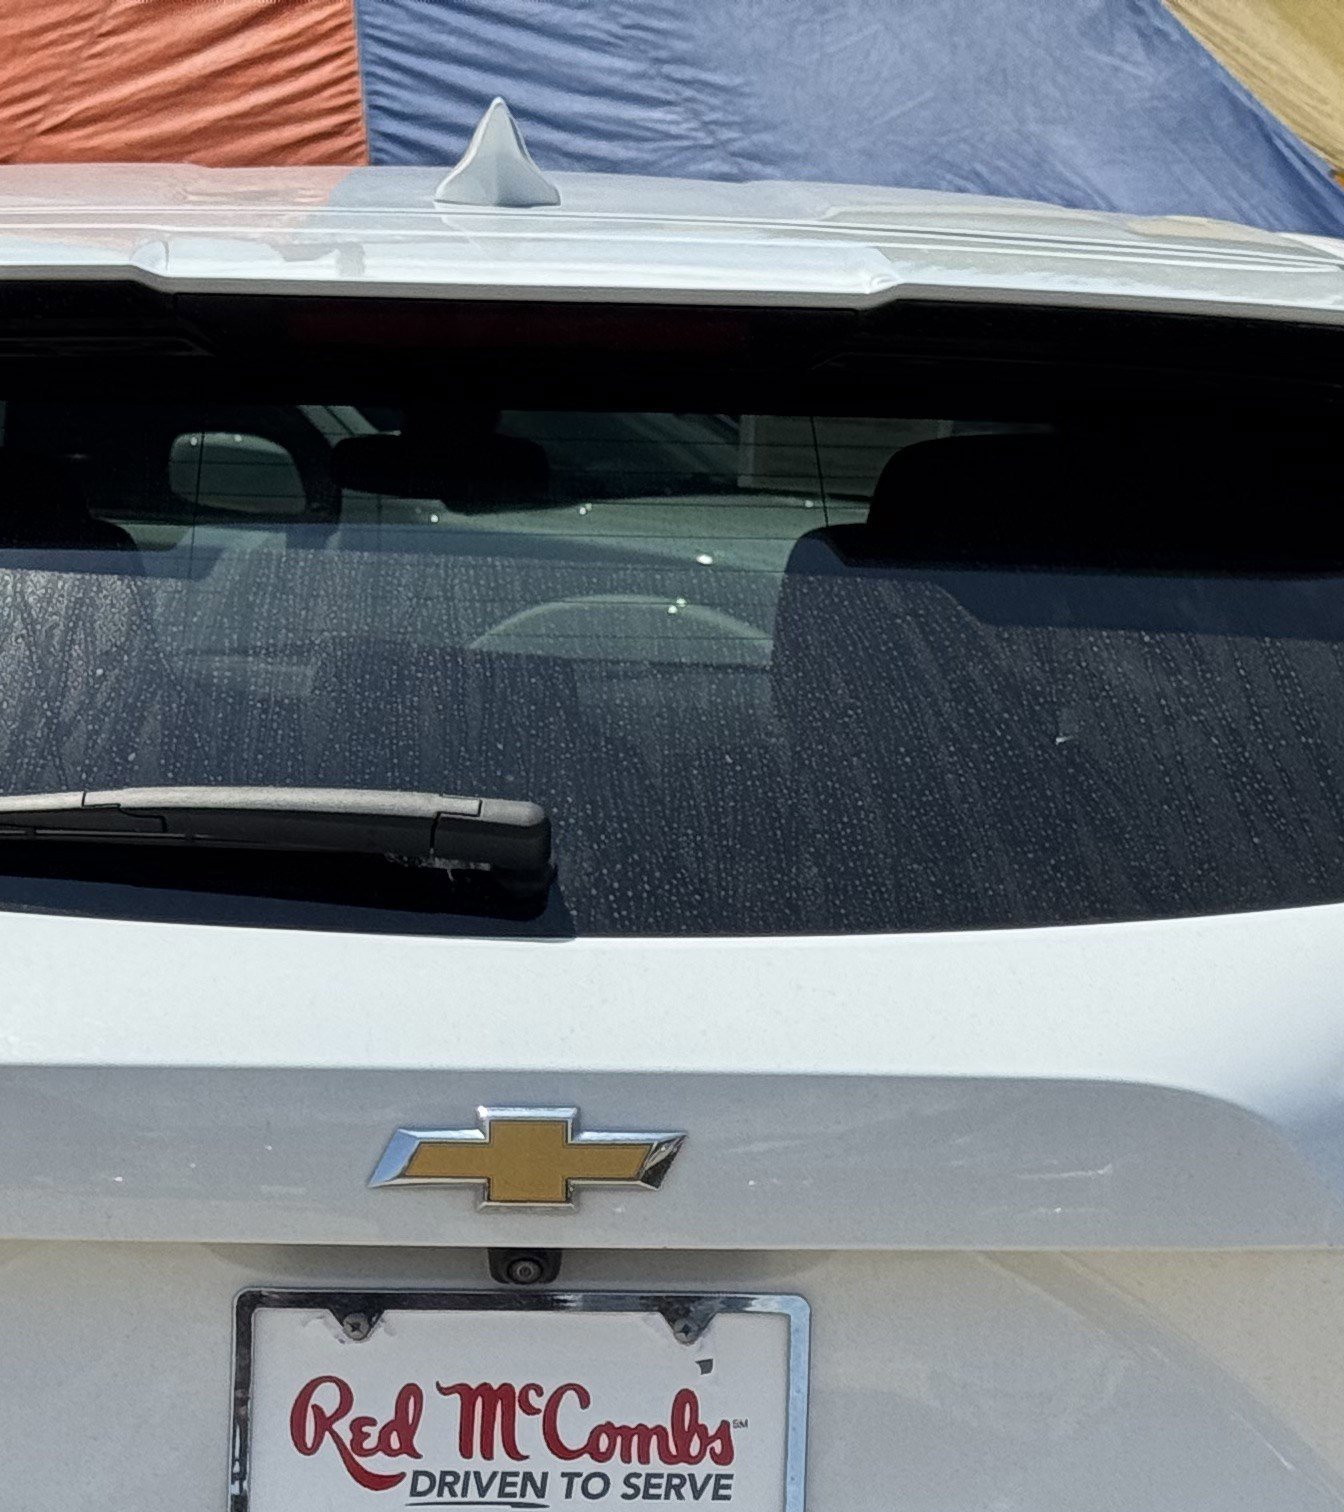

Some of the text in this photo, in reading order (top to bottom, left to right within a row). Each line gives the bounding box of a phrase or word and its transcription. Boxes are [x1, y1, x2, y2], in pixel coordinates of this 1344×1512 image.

[289, 1374, 424, 1492] Red
[434, 1380, 735, 1466] McCombs
[408, 1469, 735, 1502] DRIVEN TO SERVE
